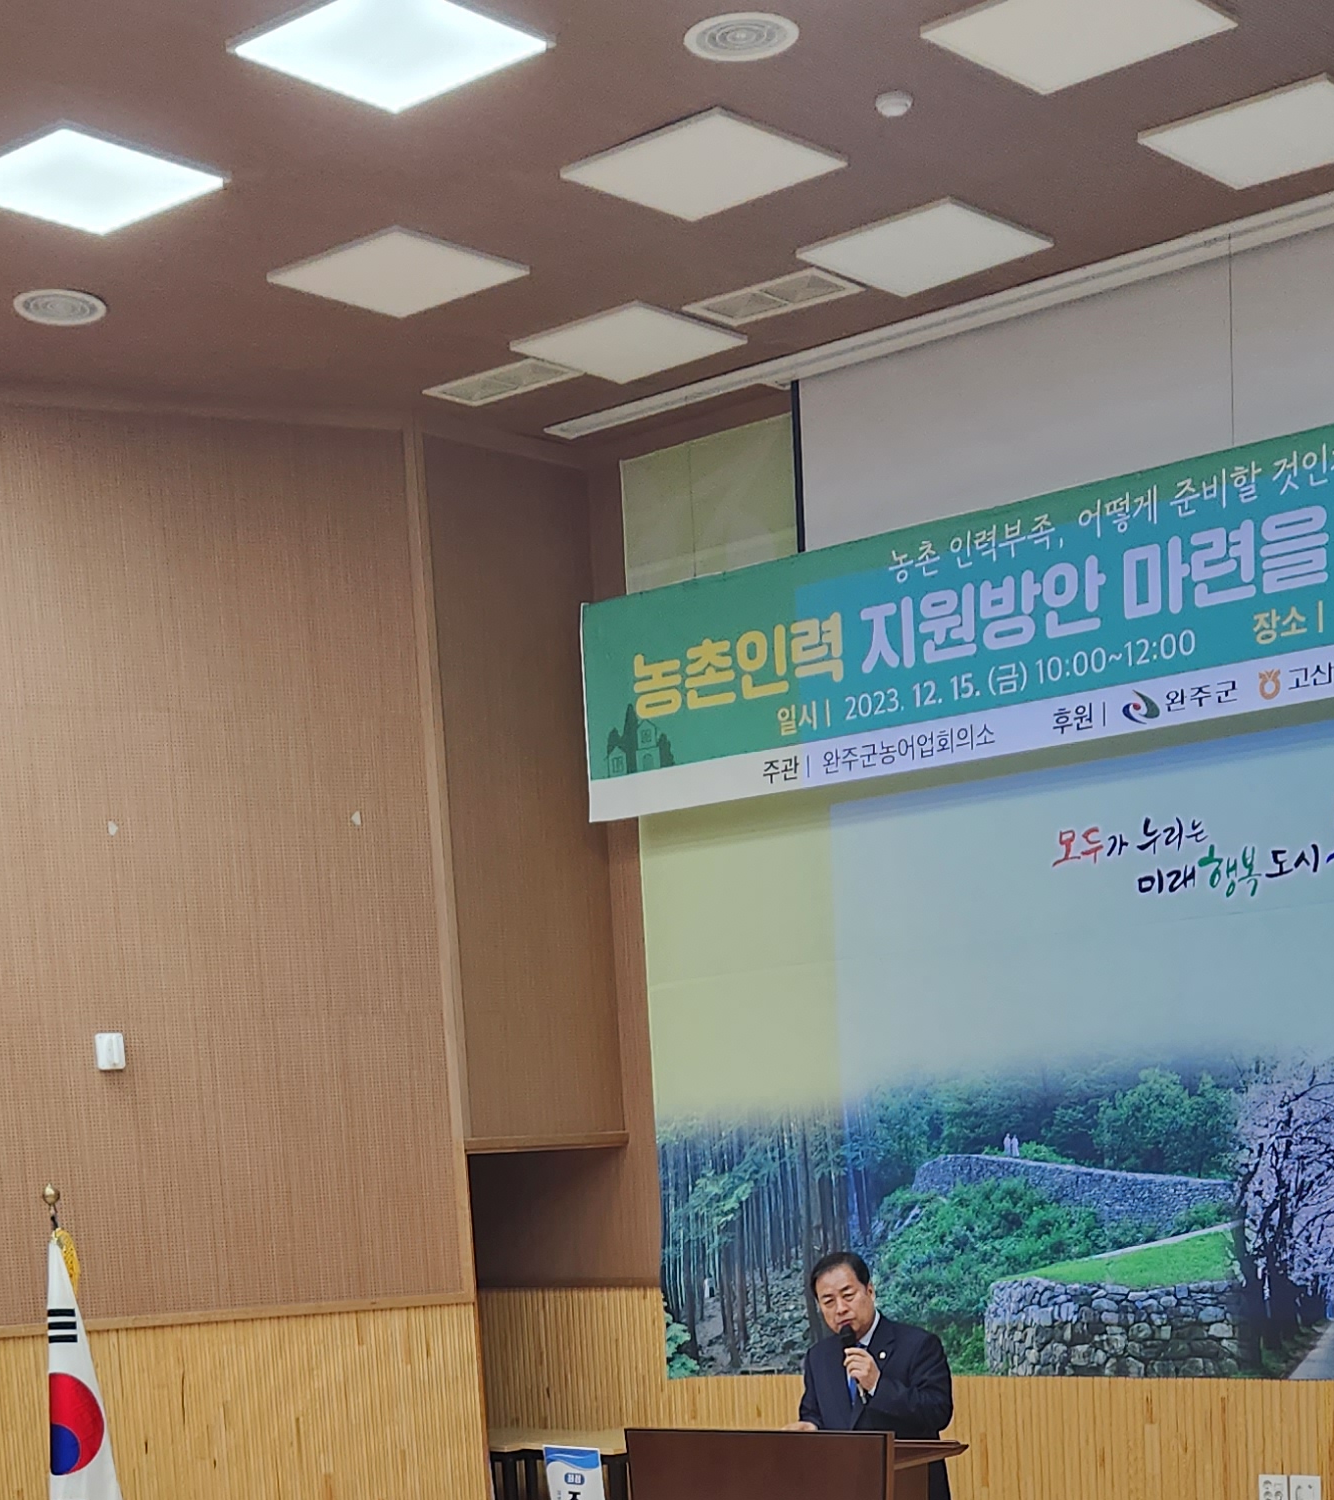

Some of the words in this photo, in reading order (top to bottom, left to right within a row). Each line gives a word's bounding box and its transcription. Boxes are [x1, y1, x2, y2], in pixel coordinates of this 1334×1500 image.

[888, 540, 940, 583] 농촌
[950, 513, 1065, 569] 인력부족,
[1078, 485, 1158, 538] 어떻게
[1170, 461, 1262, 519] 준비할
[633, 612, 844, 719] 농촌인력
[860, 554, 1107, 674] 지원방안
[1122, 505, 1329, 619] 마련을
[1253, 605, 1309, 646] 장소
[776, 700, 818, 737] 일시
[845, 687, 905, 722] 2023.
[912, 680, 943, 707] 12.
[950, 673, 981, 700] 15.
[987, 661, 1027, 697] (금)
[1035, 629, 1196, 683] 10:00~12:00
[1052, 702, 1094, 735] 후원
[1165, 680, 1239, 713] 완주군
[762, 755, 799, 784] 주관
[822, 722, 996, 776] 완주군농어업회의소
[1051, 824, 1129, 868] 모두가
[1136, 815, 1210, 854] 누리는
